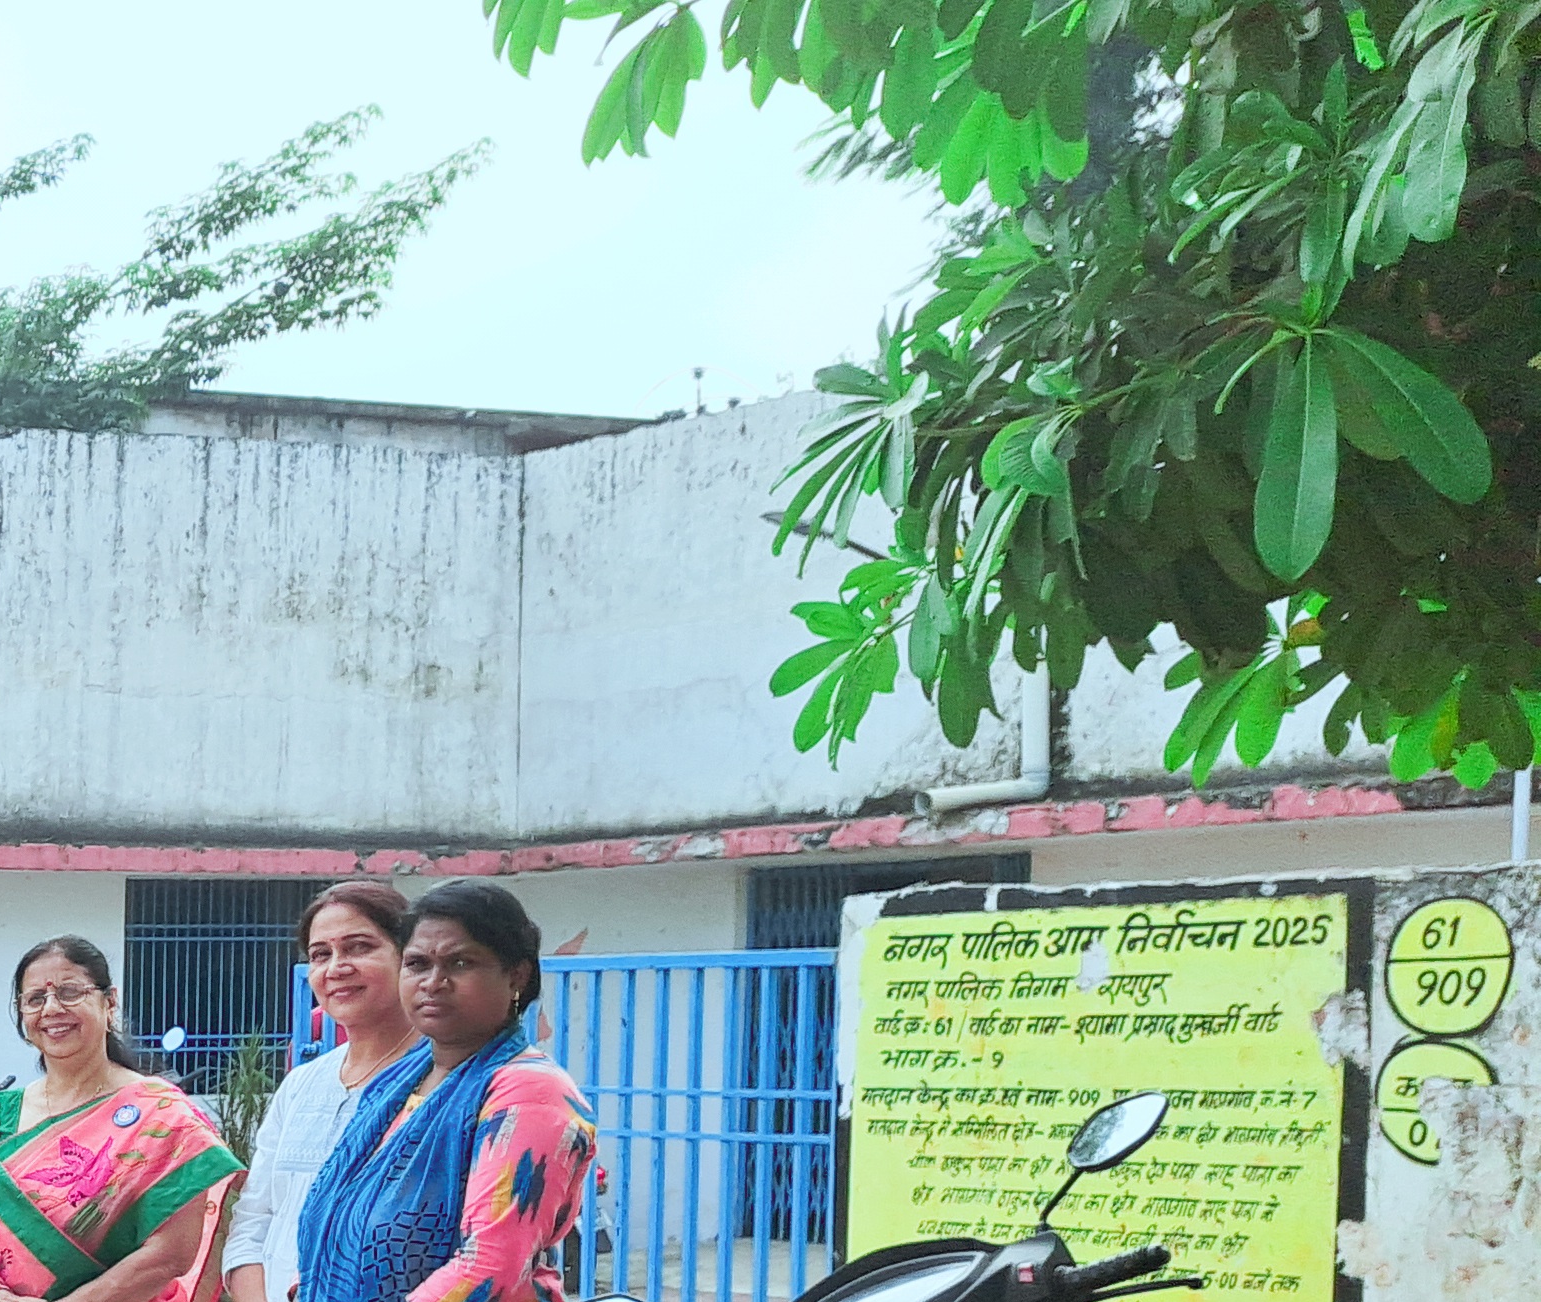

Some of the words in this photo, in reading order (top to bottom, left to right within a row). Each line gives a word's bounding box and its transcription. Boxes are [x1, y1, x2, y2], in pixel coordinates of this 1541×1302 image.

[883, 932, 954, 970] नगर
[961, 920, 1042, 962] पालिक
[1116, 908, 1247, 954] निर्वाचन
[1252, 913, 1333, 949] 2025
[1421, 914, 1461, 950] 61
[886, 979, 931, 1009] नगर
[934, 971, 1005, 1002] पालिक
[1009, 970, 1076, 999] निगम
[1097, 973, 1173, 1007] रायपुर
[1417, 966, 1487, 1007] 909
[933, 1017, 953, 1036] 61
[880, 1048, 934, 1071] भाग
[991, 1051, 1005, 1069] 9
[1068, 1089, 1101, 1109] 909
